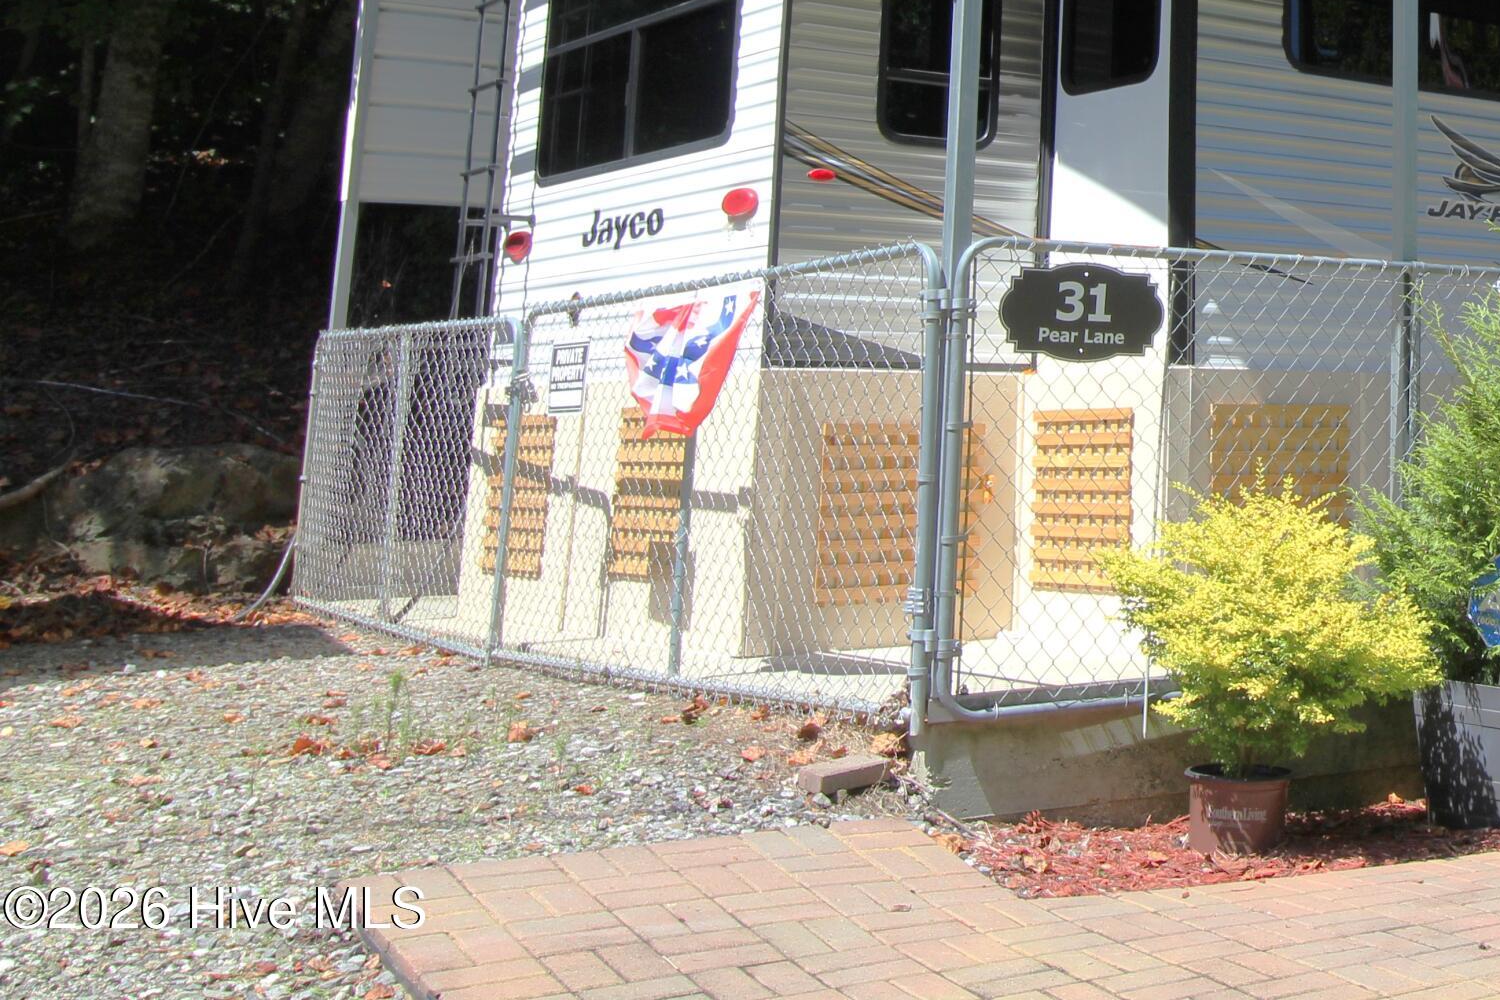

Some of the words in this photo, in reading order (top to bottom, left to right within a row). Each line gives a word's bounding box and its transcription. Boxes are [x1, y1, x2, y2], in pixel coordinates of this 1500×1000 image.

[1427, 200, 1484, 221] JAY
[582, 207, 665, 250] Jayco
[1056, 281, 1112, 323] 31
[1038, 327, 1079, 343] Pear
[1083, 328, 1125, 345] Lane
[555, 346, 585, 366] PRIVATE
[551, 363, 586, 383] PROPERTY
